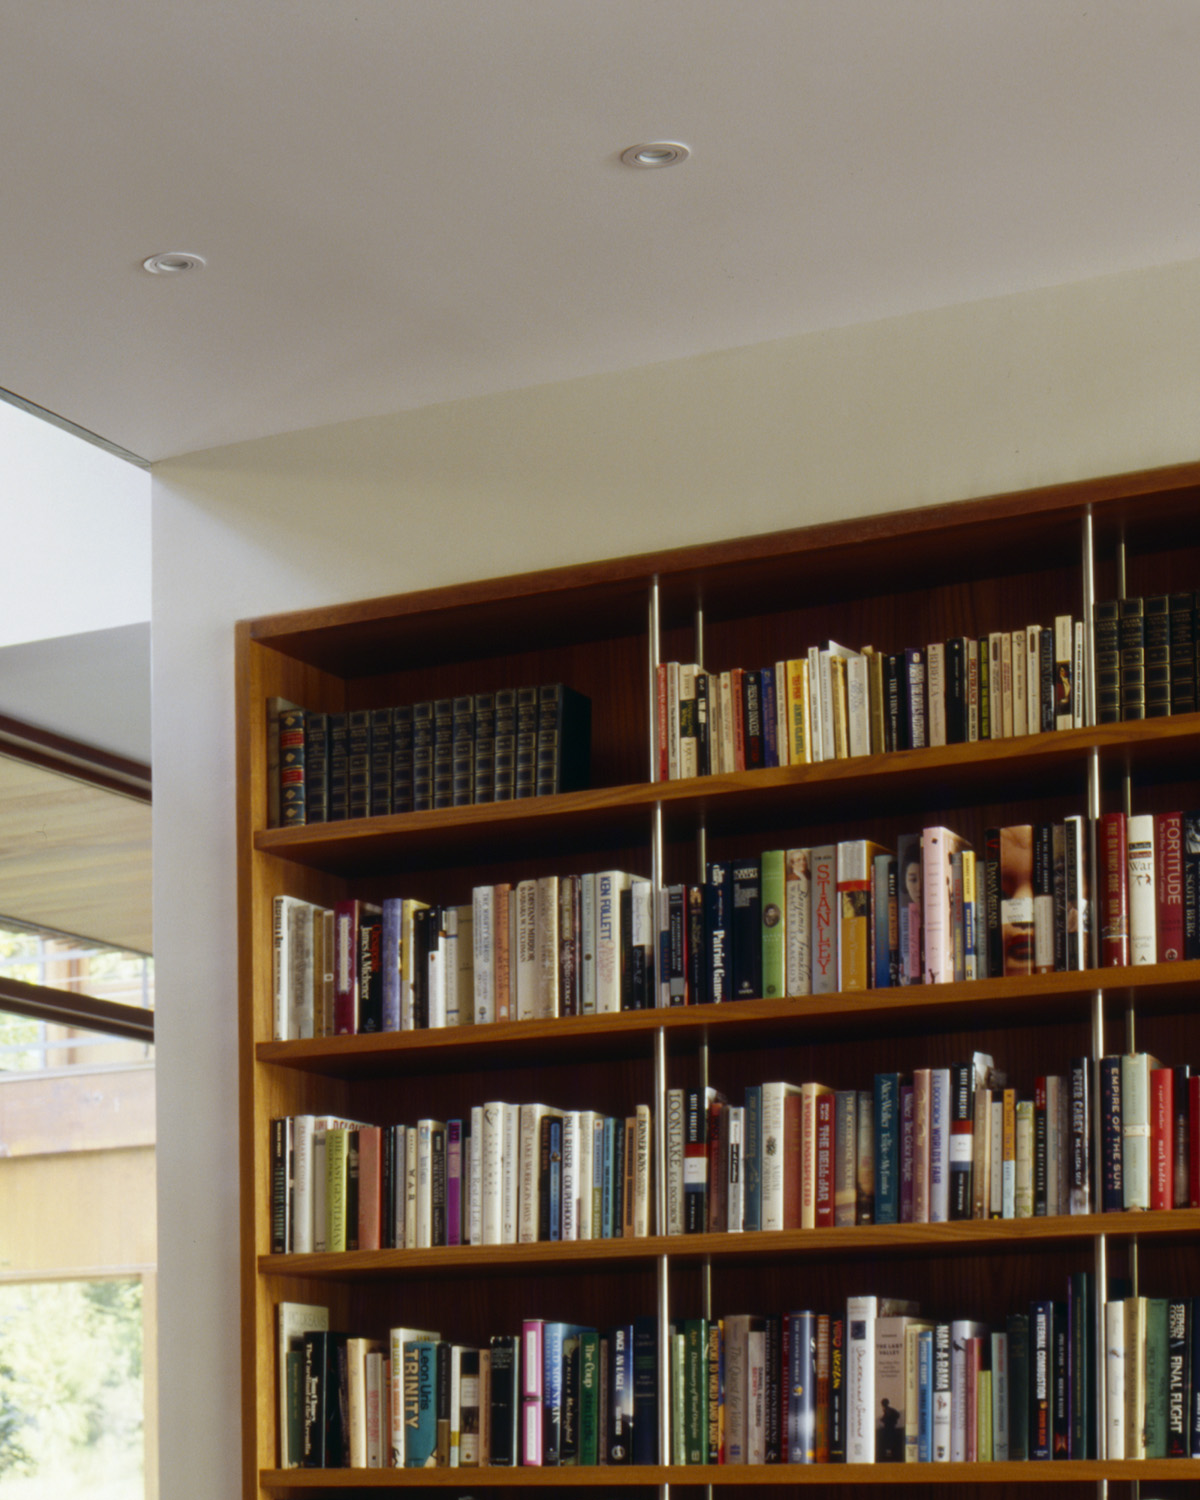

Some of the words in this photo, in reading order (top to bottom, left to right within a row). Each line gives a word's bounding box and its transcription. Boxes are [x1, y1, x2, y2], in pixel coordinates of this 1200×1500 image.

[889, 678, 897, 694] THE
[930, 653, 939, 697] REBECCA
[969, 658, 978, 706] DELIVERANCE
[794, 704, 802, 726] JAMES
[889, 695, 898, 714] FIRM
[795, 727, 804, 754] CLAVELL
[1107, 822, 1117, 836] THE
[1108, 850, 1118, 871] VINCI
[1128, 861, 1153, 872] War
[1167, 818, 1181, 905] FORTITUDE
[600, 876, 611, 896] KEN
[988, 862, 998, 888] DIANA
[1068, 869, 1076, 895] PARK
[1108, 874, 1118, 892] CODE
[1185, 874, 1194, 907] SCOTT
[527, 892, 535, 926] DISTANT
[600, 898, 611, 941] FOLLETT
[794, 889, 810, 935] Benjamin
[816, 864, 832, 976] STANLEY
[1109, 899, 1119, 914] DAN
[1186, 909, 1195, 937] BERG
[361, 925, 372, 951] James
[527, 928, 535, 962] MIRROR
[713, 930, 725, 967] Patriot
[797, 940, 811, 982] Franklin
[361, 961, 372, 999] Michener
[713, 969, 725, 1004] Games
[881, 1079, 892, 1100] Alice
[959, 1068, 968, 1086] SUITE
[1072, 1069, 1083, 1099] PETER
[1111, 1068, 1120, 1114] EMPIRE
[564, 1115, 572, 1137] PAUL
[669, 1093, 681, 1132] LOON
[804, 1102, 812, 1138] WORLD
[1072, 1101, 1084, 1134] CAREY
[1112, 1116, 1120, 1132] OF
[524, 1136, 534, 1158] LAKE
[638, 1120, 646, 1151] BONNER
[819, 1125, 829, 1149] THE
[932, 1127, 941, 1163] WORLD'S
[1112, 1136, 1121, 1161] THE
[564, 1139, 572, 1168] REISER
[638, 1153, 646, 1173] BOYS
[670, 1133, 681, 1168] LAKE
[819, 1150, 829, 1177] BELL
[1158, 1140, 1166, 1163] mark
[408, 1169, 416, 1201] WAR
[472, 1177, 482, 1197] Rest
[524, 1160, 534, 1202] WOBEGON
[932, 1166, 942, 1184] FAIR
[1113, 1163, 1121, 1190] SUN
[1157, 1165, 1166, 1193] haddon
[564, 1175, 572, 1230] COUPLEHOOD
[817, 1178, 828, 1202] JAR
[334, 1183, 342, 1246] GENTLEMAN
[1036, 1314, 1046, 1349] INTERNAL
[1176, 1304, 1185, 1339] STEPHEN
[552, 1332, 560, 1363] COLD
[584, 1343, 595, 1361] The
[616, 1331, 624, 1353] ONCE
[730, 1347, 741, 1363] The
[420, 1348, 432, 1382] Leon
[616, 1354, 624, 1366] AN
[690, 1352, 698, 1386] Dictionary
[710, 1364, 718, 1373] TO
[936, 1325, 949, 1390] NAM-A-RAMA
[583, 1362, 595, 1388] Coup
[616, 1367, 624, 1392] EAGLE
[730, 1366, 742, 1394] Quest
[1036, 1350, 1047, 1399] COMBUSTION
[1170, 1356, 1182, 1388] FINAL
[405, 1349, 419, 1429] TRINITY
[420, 1385, 432, 1411] Uris
[552, 1366, 561, 1424] MOUNTAIN
[709, 1375, 718, 1399] WORLD
[710, 1401, 718, 1420] BAND
[1170, 1392, 1182, 1433] FLIGHT
[710, 1423, 718, 1444] RADIO
